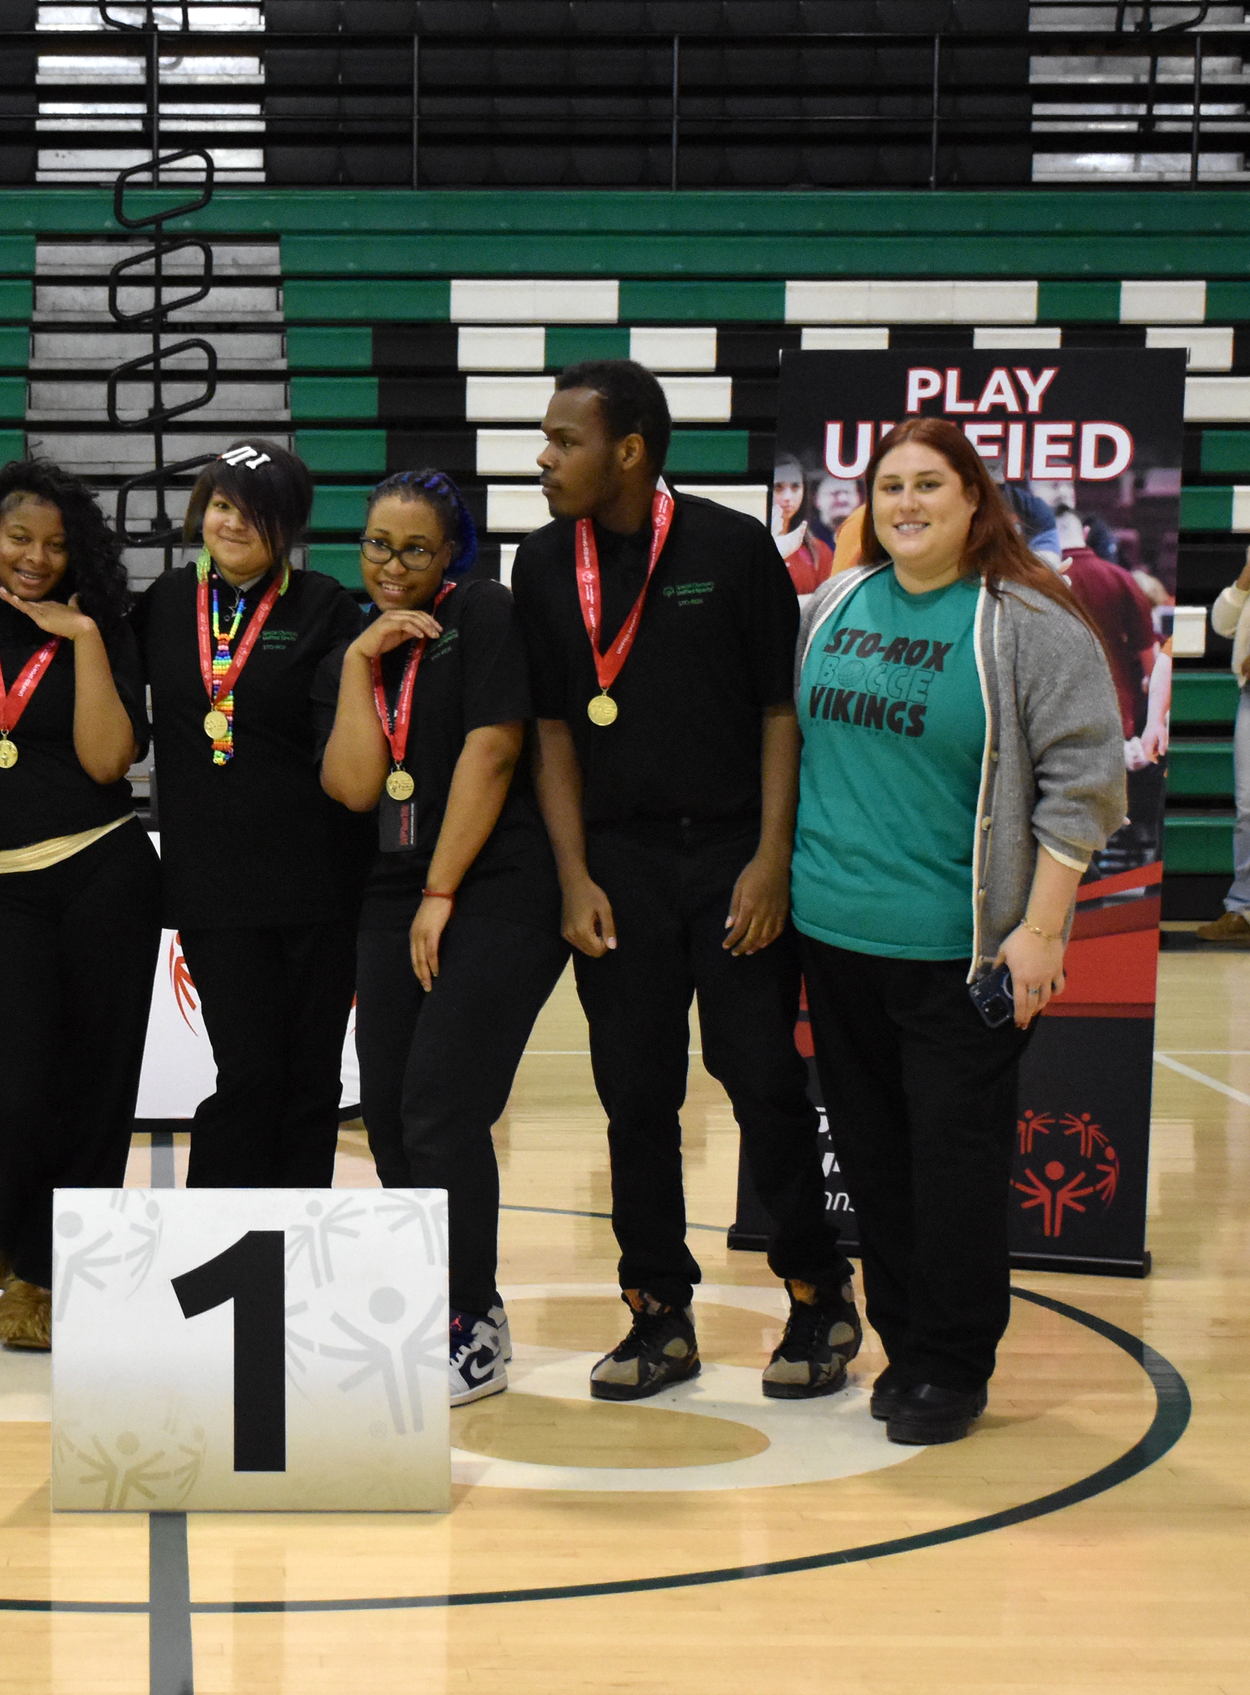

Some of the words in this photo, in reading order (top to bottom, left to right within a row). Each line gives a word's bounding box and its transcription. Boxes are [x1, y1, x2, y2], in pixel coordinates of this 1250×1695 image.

[905, 367, 1059, 414] PLAY
[824, 420, 1135, 482] UFIED
[823, 627, 953, 672] STO-ROX
[809, 686, 927, 737] VIKINGS
[170, 1230, 286, 1472] 1
